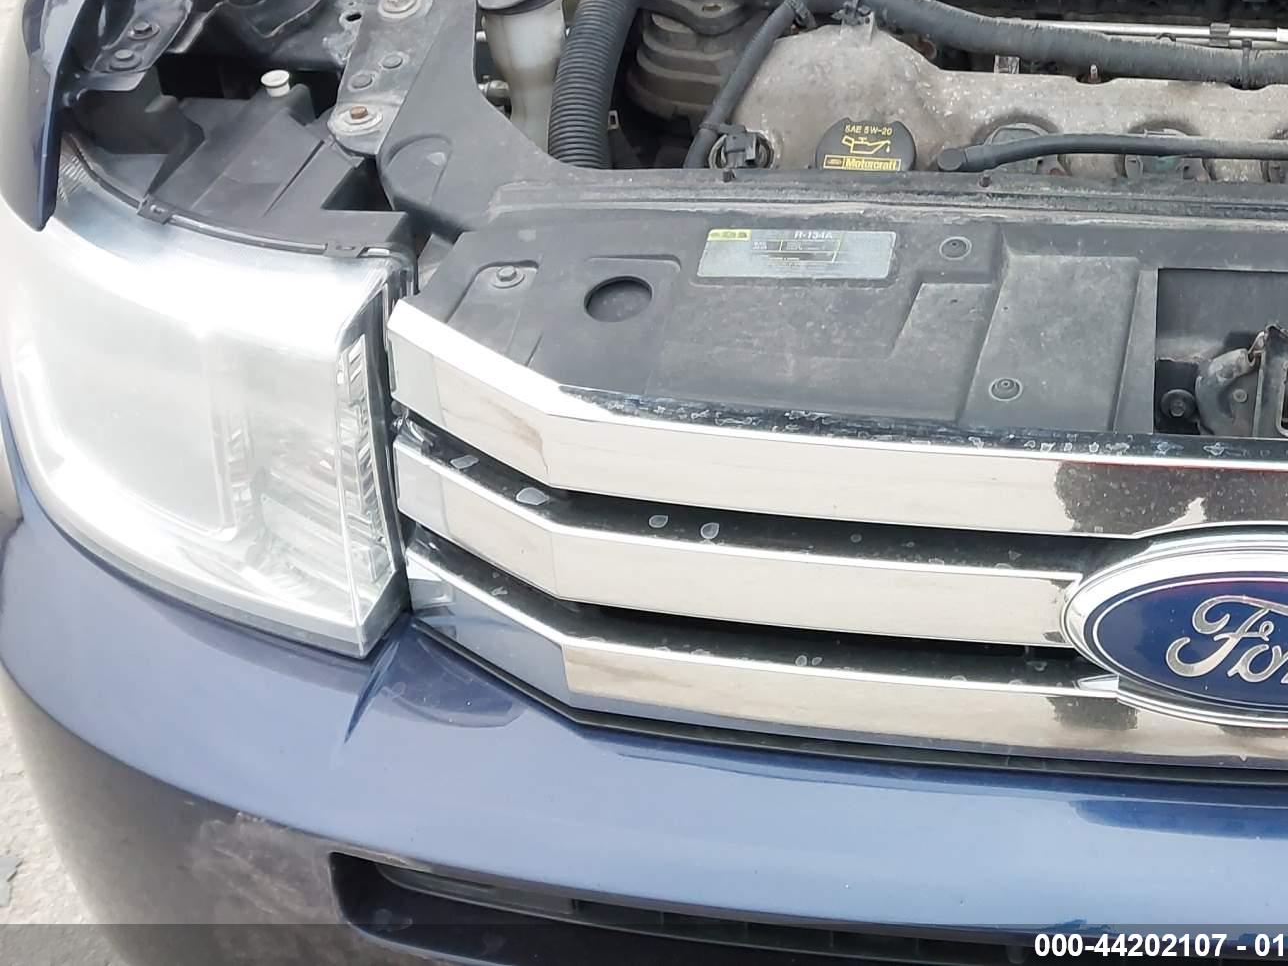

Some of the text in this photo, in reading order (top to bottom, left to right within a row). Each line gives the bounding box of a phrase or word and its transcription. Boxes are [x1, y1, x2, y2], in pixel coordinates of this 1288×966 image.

[845, 124, 893, 136] SAE 5W-20
[846, 157, 897, 171] Motorcraft
